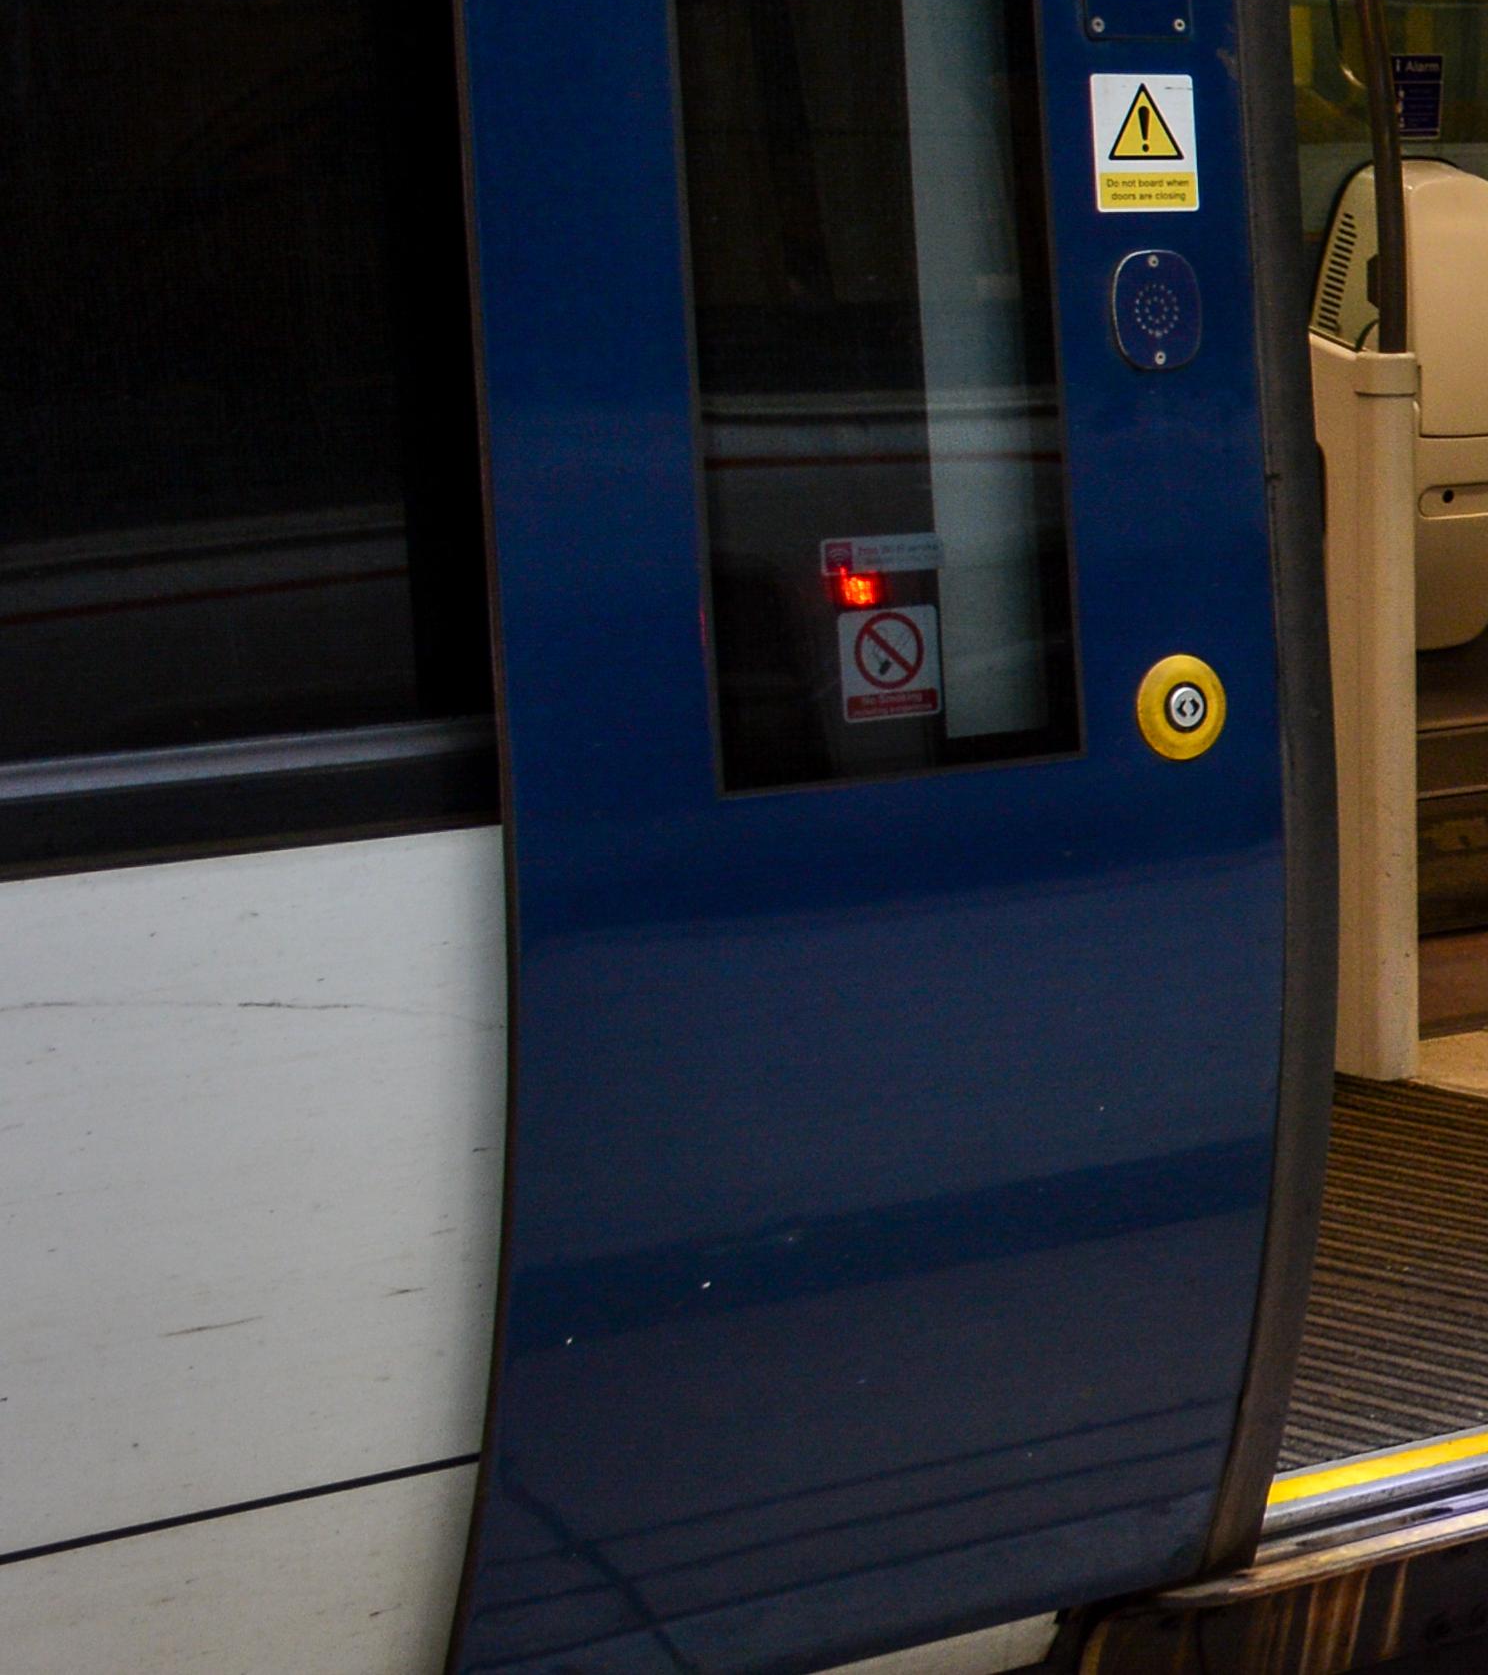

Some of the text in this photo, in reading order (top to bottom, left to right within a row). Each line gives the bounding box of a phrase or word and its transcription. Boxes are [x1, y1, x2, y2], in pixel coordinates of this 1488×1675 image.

[1404, 60, 1440, 71] Alarm
[1106, 178, 1190, 188] Do not board when
[1111, 192, 1187, 203] doors are closing
